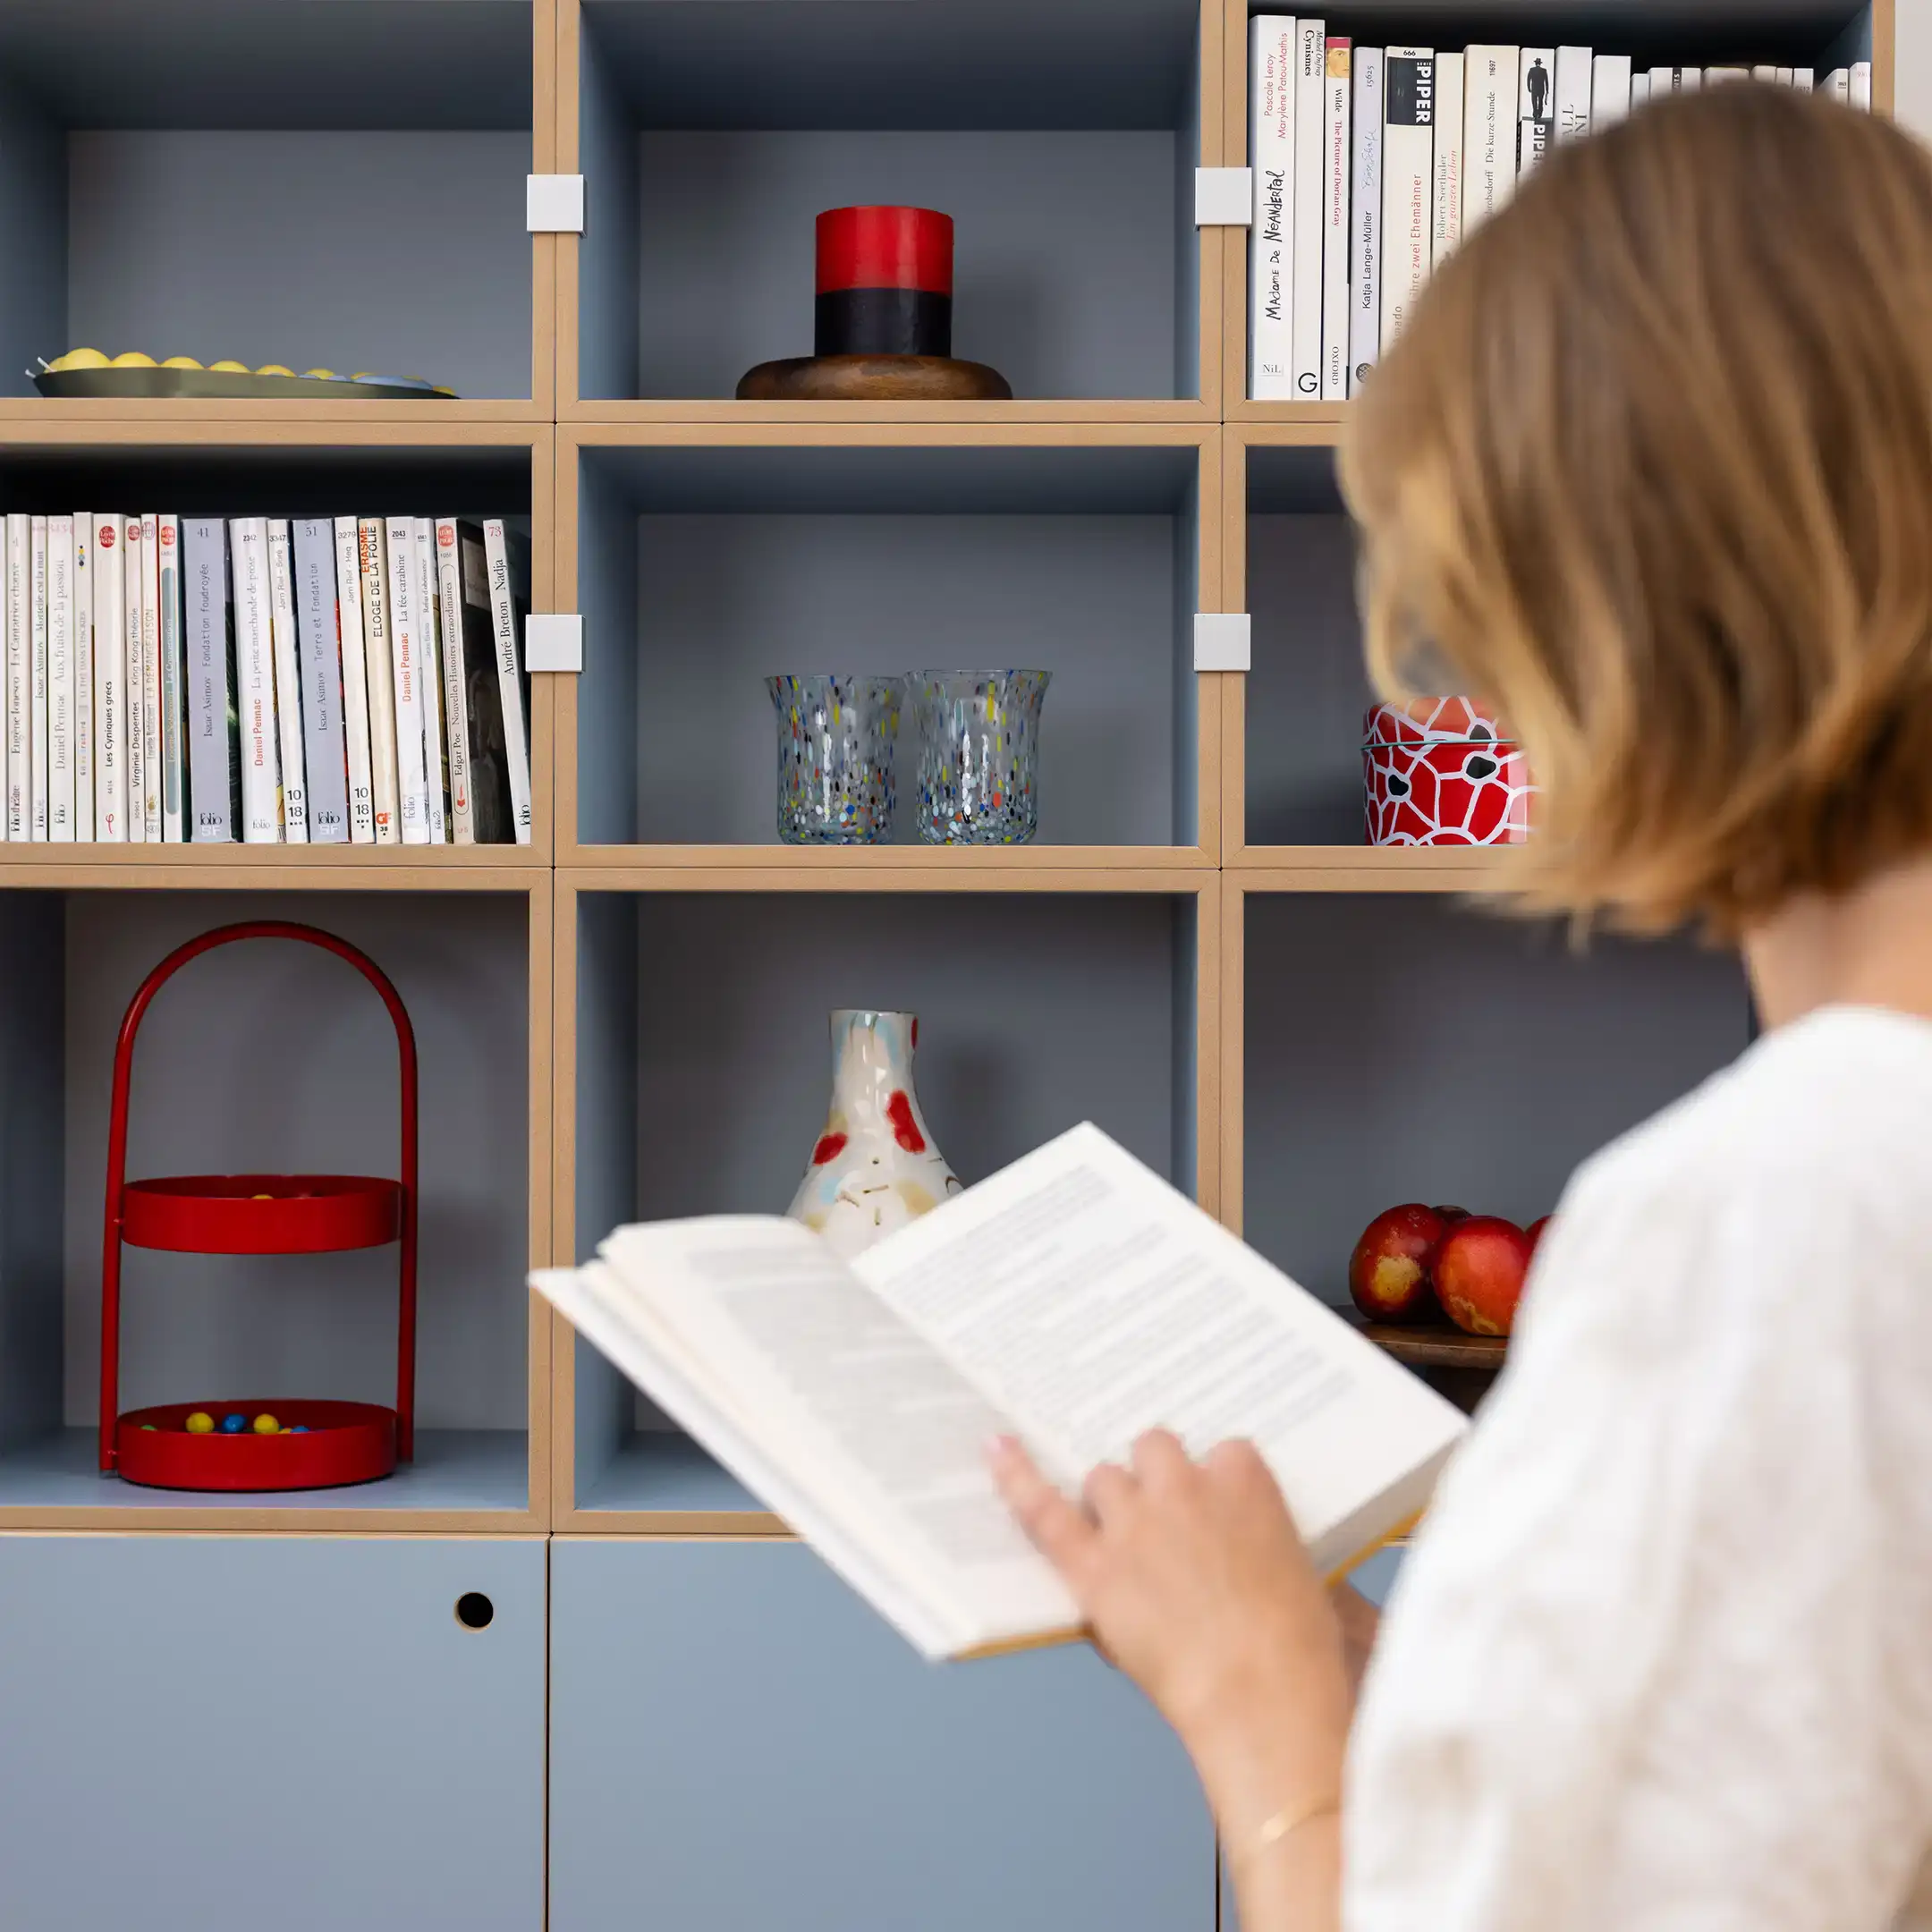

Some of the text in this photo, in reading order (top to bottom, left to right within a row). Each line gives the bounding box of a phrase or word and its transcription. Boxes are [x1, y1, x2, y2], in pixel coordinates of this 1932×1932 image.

[1304, 30, 1315, 77] Cynismes
[1314, 30, 1323, 77] Michel Onfray
[1365, 65, 1375, 88] 15625
[1264, 54, 1276, 116] Pascale Leroy
[1277, 32, 1289, 139] Marylène Patou-Mathis
[1416, 66, 1431, 123] PIPER
[1332, 89, 1343, 226] Wilde The Picture of Dorian Gray
[1485, 91, 1496, 216] hrobsdorff Die kurze Stunde
[1533, 124, 1546, 166] PIPE
[1436, 155, 1447, 239] Robert Seethaler
[1446, 150, 1458, 240] Ein ganzes Leben
[1410, 174, 1421, 296] ihre zwei Ehemänner
[1362, 210, 1373, 309] Katja Lange-Müller
[1298, 372, 1318, 393] G
[198, 528, 208, 537] 41
[306, 527, 318, 537] 51
[337, 531, 357, 539] 3279
[360, 526, 369, 573] ERASME
[488, 526, 502, 537] 73
[368, 526, 383, 638] ELOGE DE LA FOLIE
[422, 597, 430, 613] Refus
[35, 551, 45, 699] Isaac Asimov Mortelle est la nuit
[396, 555, 411, 702] Daniel Pennac La fée carabine
[493, 559, 515, 676] André Breton Nadja
[11, 563, 24, 754] Eugène Ionesco La Cantatrice chauve
[55, 559, 68, 769] Daniel Pennac Aux fruits de la passion
[199, 564, 213, 737] Isaac Asimov Fondation foudroyée
[247, 556, 264, 767] Daniel Pennac La petite marchande de prose
[310, 563, 327, 731] Isaac Asimov Terre et Fondation
[131, 607, 142, 787] Virginie Despentes King Kong théorie
[445, 581, 466, 775] Edgar Poe Nouvelles Histoires extraordinaires
[105, 681, 114, 767] Les Cyniques grecs
[287, 790, 301, 801] 10
[289, 807, 302, 818] 18
[354, 788, 369, 799] 10
[355, 804, 369, 815] 18
[403, 796, 416, 819] folio
[520, 804, 531, 826] folio
[199, 812, 222, 826] folio
[201, 826, 222, 837] SF
[253, 819, 271, 830] folio
[318, 811, 340, 825] folio
[319, 825, 340, 835] SF
